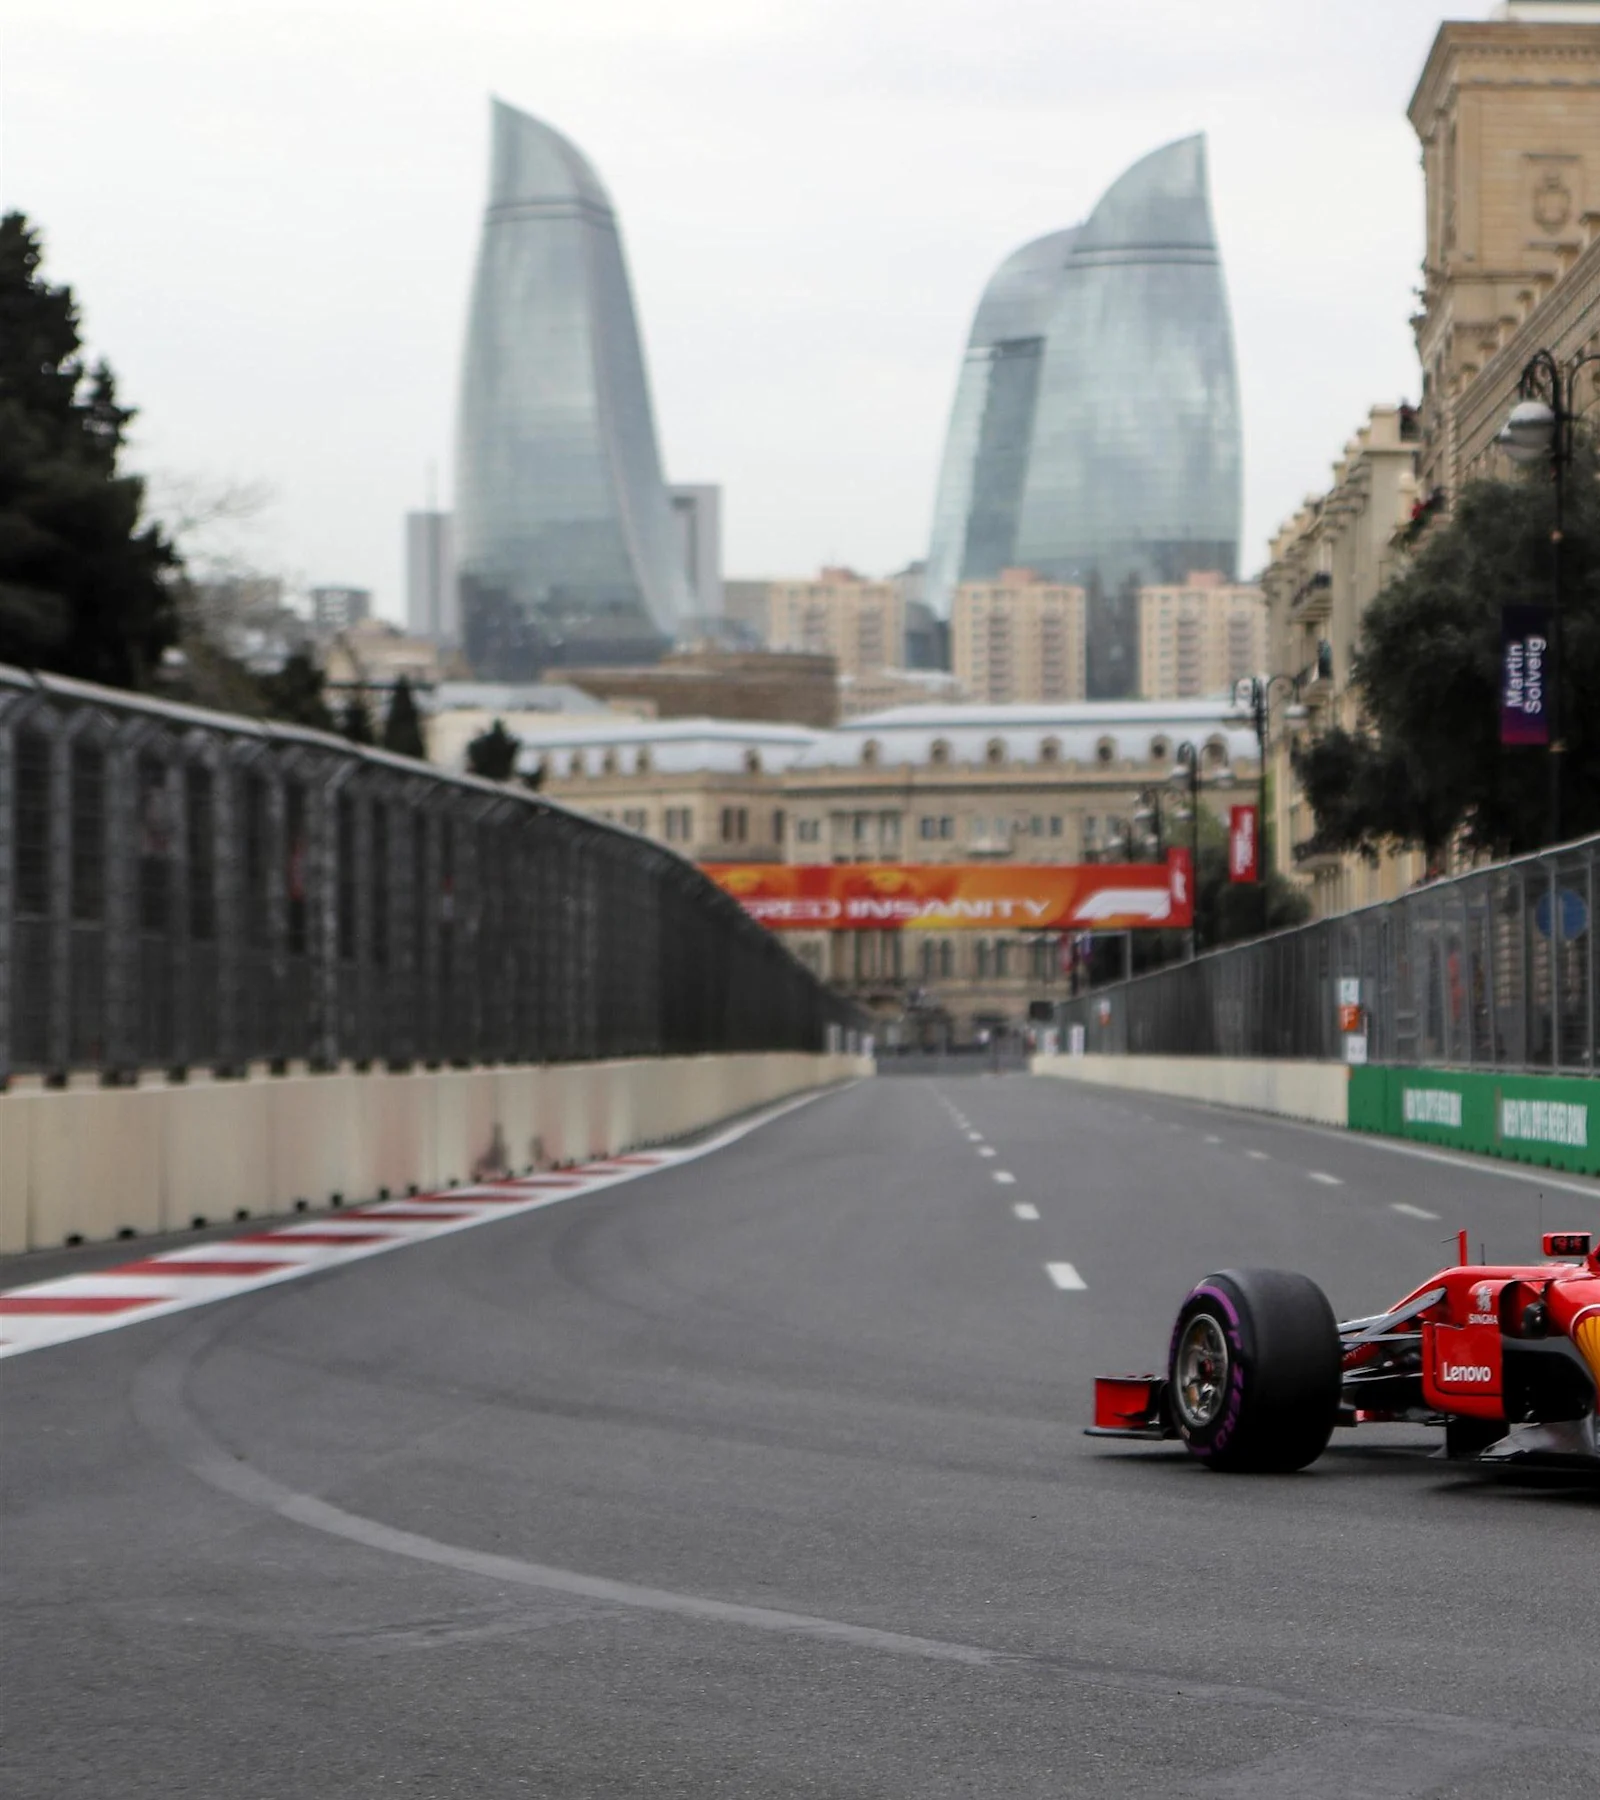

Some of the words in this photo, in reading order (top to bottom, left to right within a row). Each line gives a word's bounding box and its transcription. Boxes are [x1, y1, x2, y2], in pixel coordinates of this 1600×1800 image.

[1506, 644, 1523, 707] Martin
[1525, 637, 1546, 713] Solveig
[848, 897, 1051, 919] INSANITY
[1443, 1361, 1492, 1382] Lenovo
